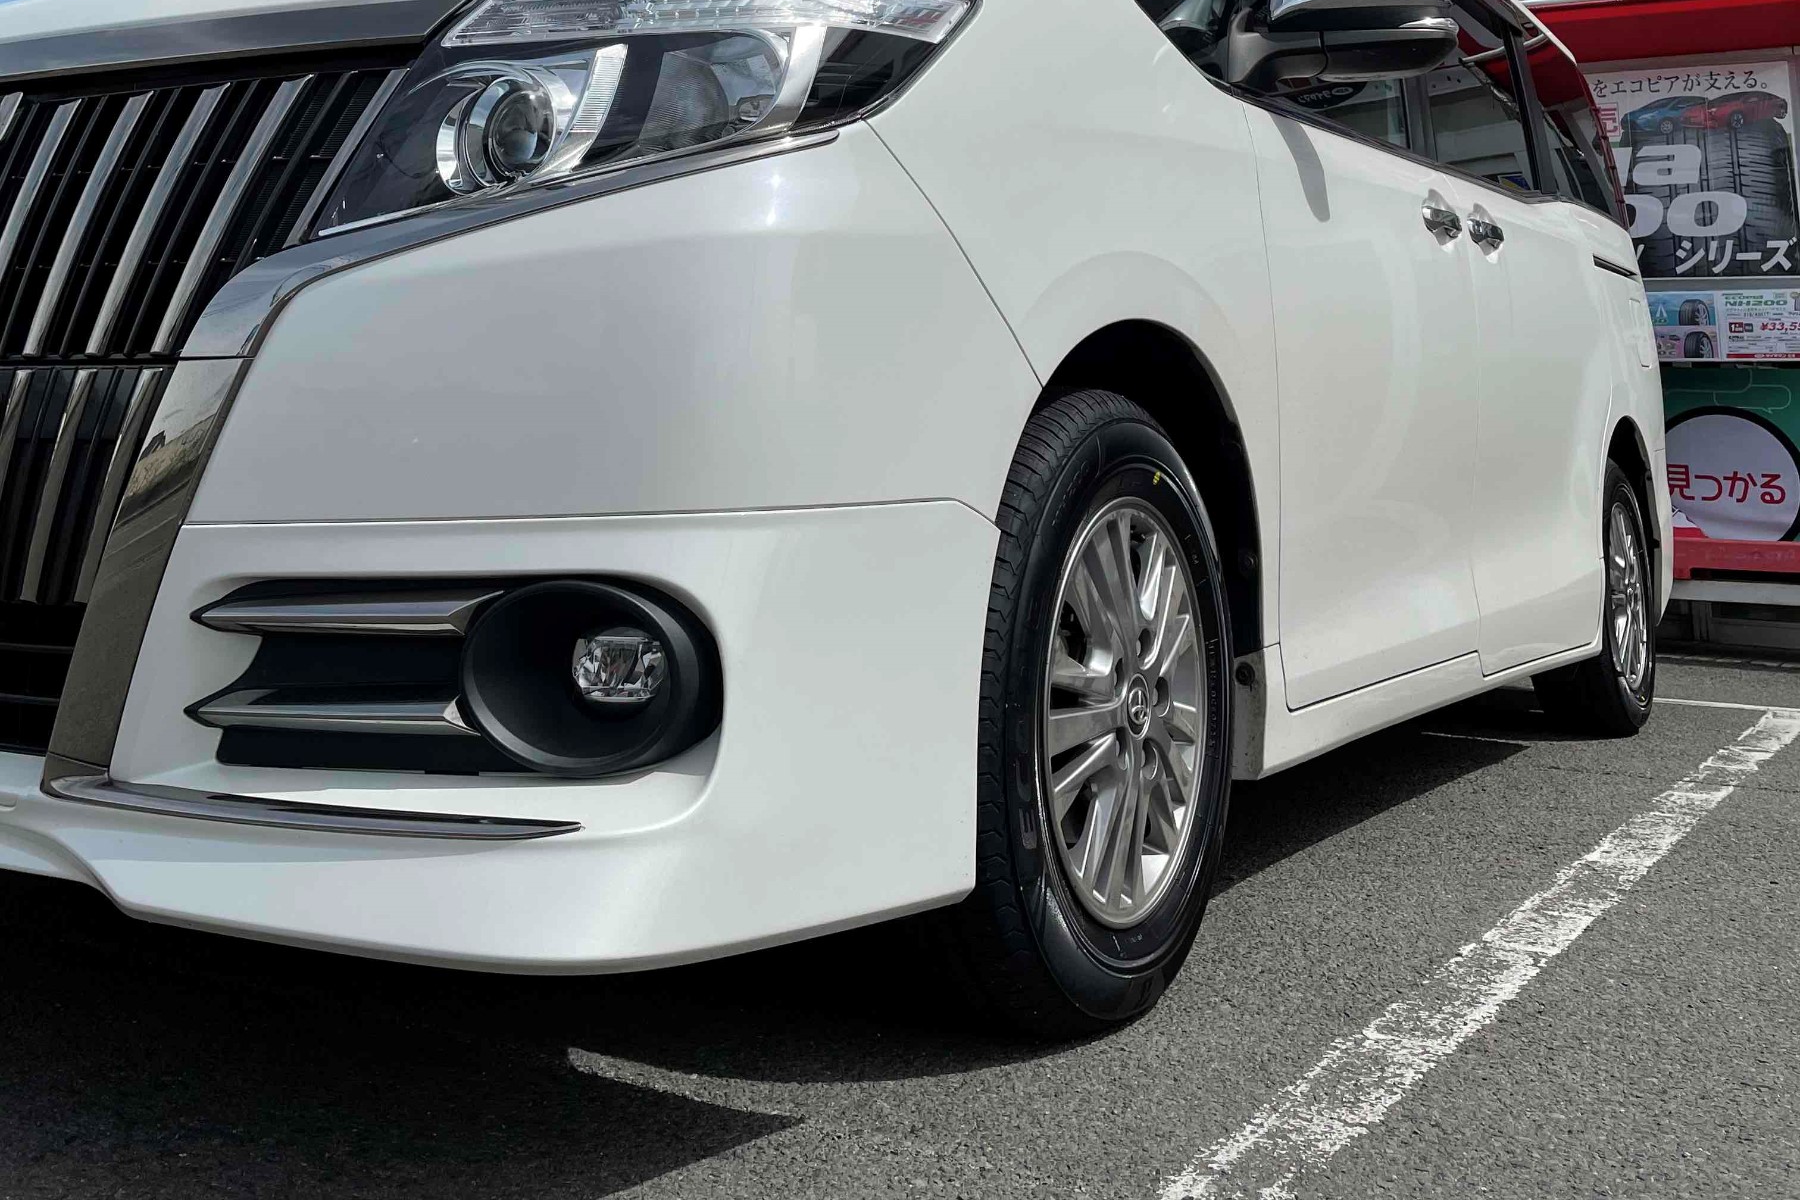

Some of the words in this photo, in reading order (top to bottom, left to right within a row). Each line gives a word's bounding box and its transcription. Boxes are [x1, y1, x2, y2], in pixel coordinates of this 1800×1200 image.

[1593, 70, 1768, 98] をエコピアが支える。
[1675, 237, 1798, 275] シリーズ
[1667, 464, 1786, 504] 見つかる
